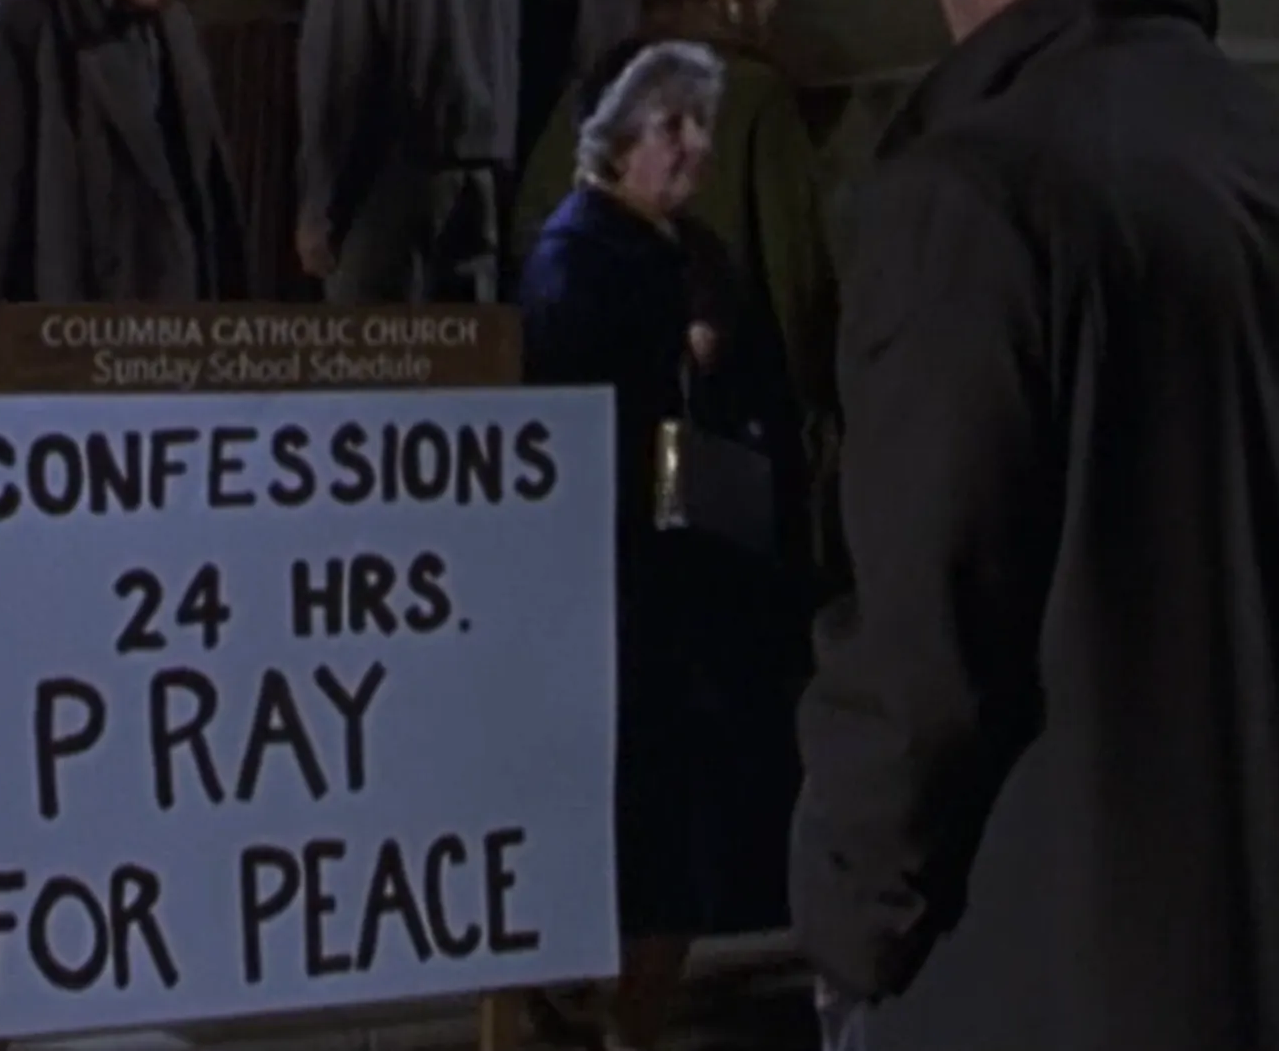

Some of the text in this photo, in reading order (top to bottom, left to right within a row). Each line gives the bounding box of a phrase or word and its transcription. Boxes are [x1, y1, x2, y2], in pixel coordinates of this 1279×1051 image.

[41, 315, 479, 347] COLUMBIA CATHOLIC CHURCH
[91, 349, 432, 389] Sunday School Schedule
[114, 551, 471, 653] 24 HRS.
[34, 661, 386, 820] PRAY
[240, 827, 540, 984] PEACE
